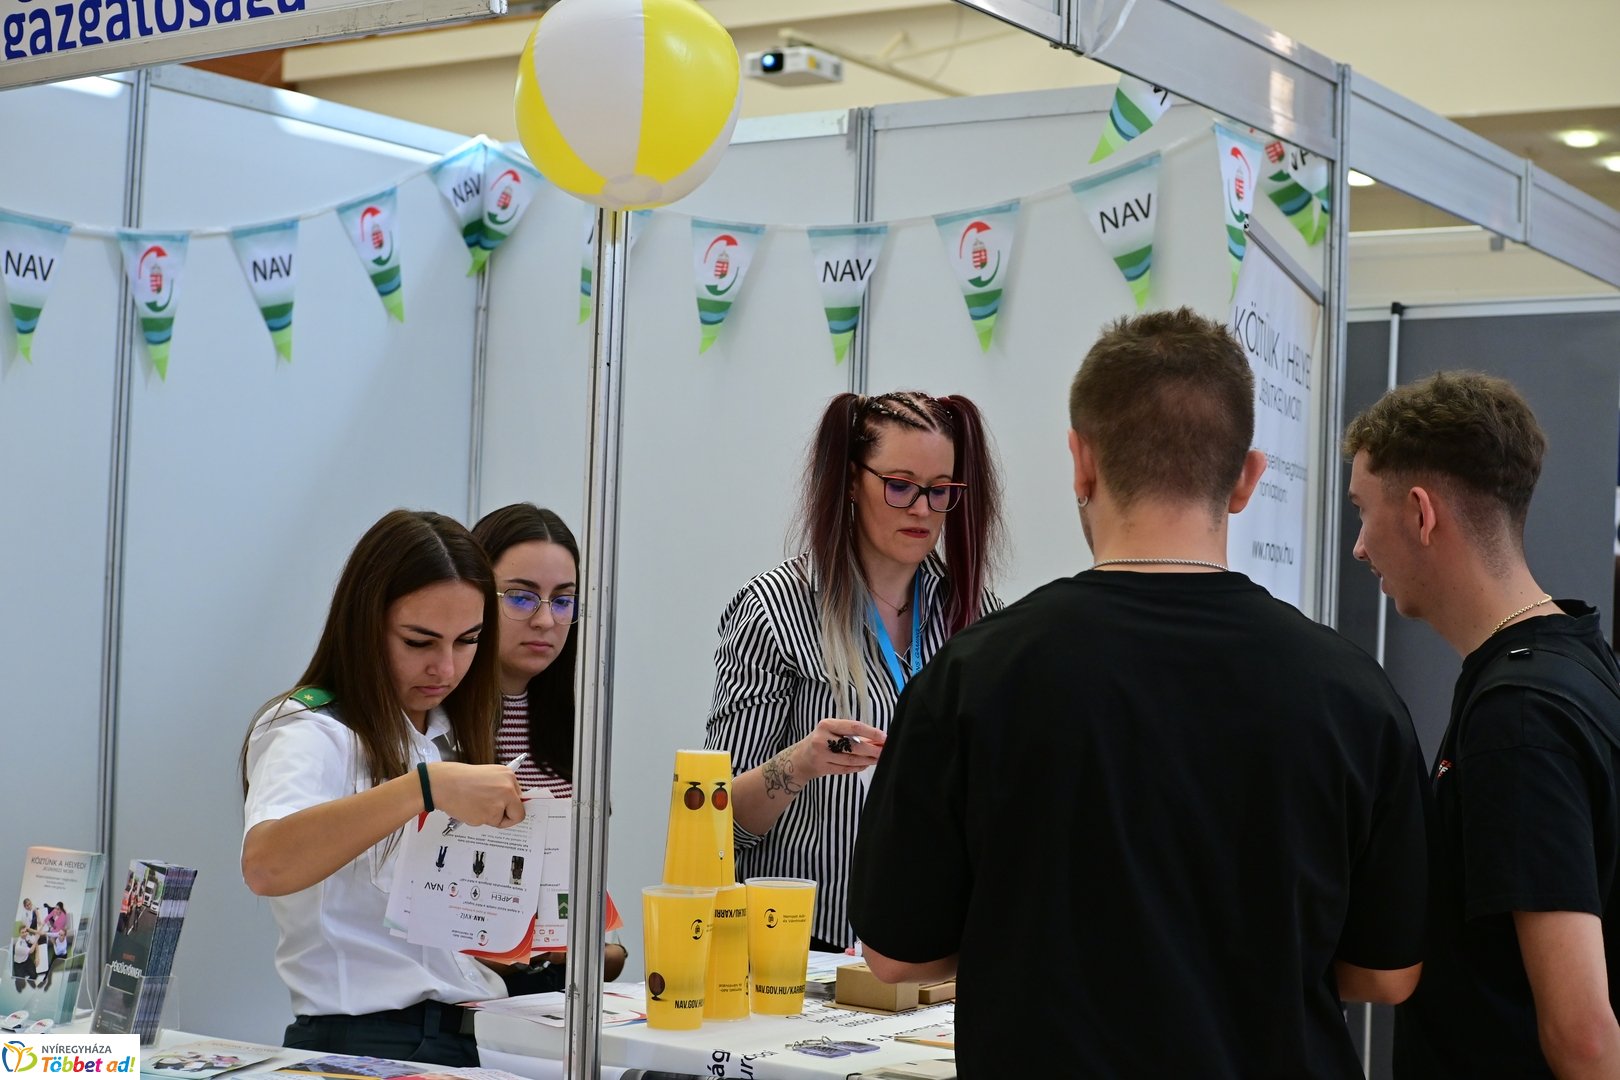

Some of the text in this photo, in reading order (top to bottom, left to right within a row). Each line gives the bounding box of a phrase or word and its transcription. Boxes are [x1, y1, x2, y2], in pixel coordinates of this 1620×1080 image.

[452, 174, 481, 207] NAV
[1099, 193, 1152, 234] NAV
[4, 250, 54, 282] NAV
[252, 254, 293, 283] NAV
[822, 258, 872, 283] NAV
[424, 881, 444, 892] NAV
[491, 893, 513, 903] APEH
